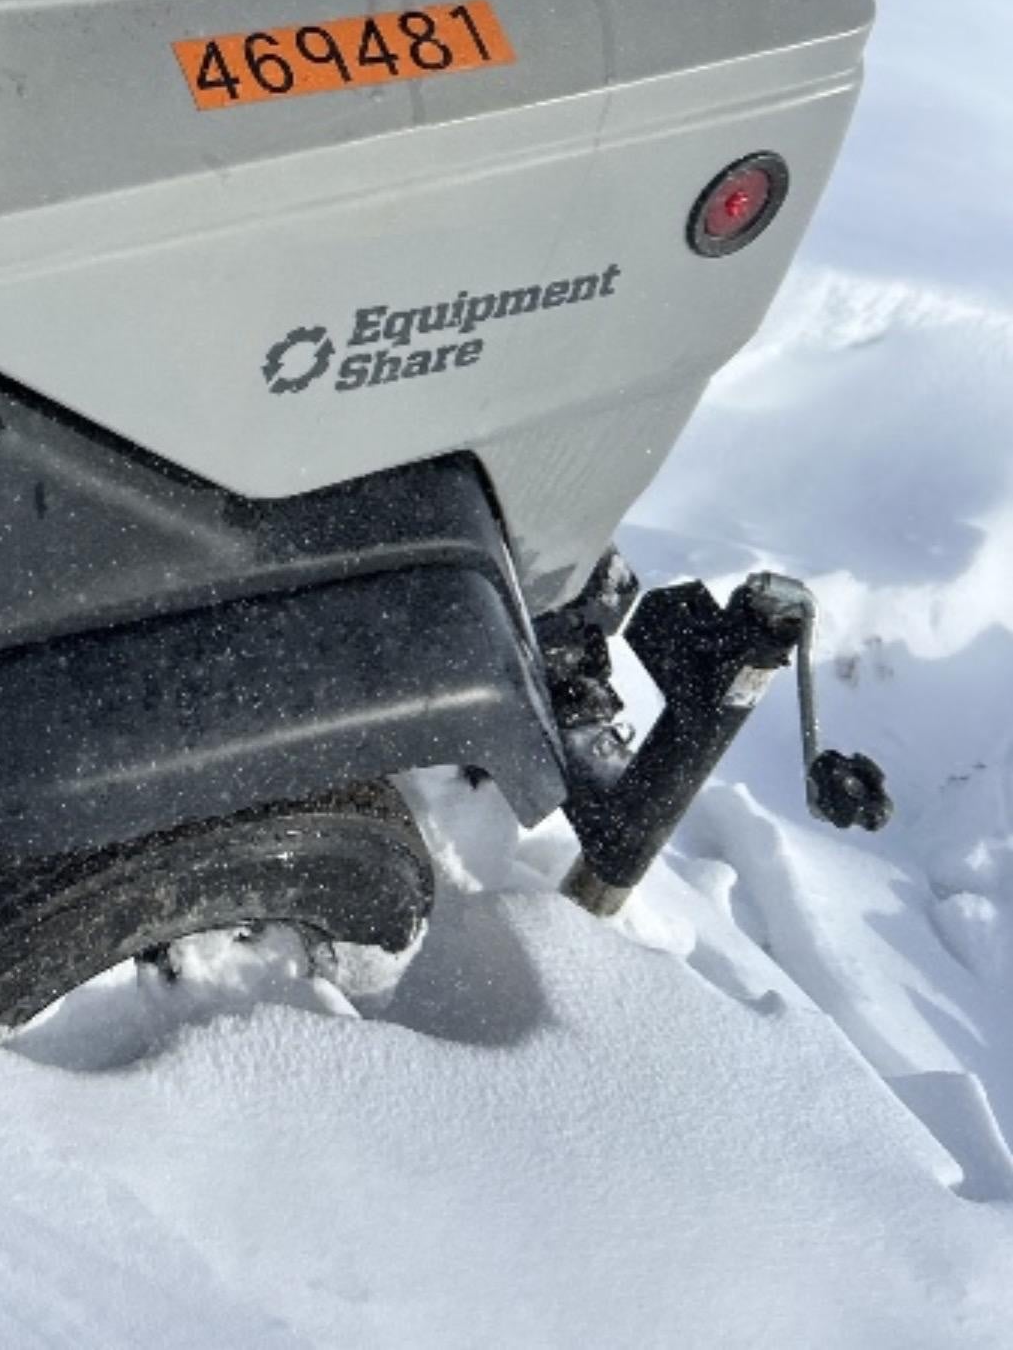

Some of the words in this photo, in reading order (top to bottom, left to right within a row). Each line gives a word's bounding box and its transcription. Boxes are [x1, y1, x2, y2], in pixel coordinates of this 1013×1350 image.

[196, 5, 492, 100] 469481
[346, 263, 621, 348] Equipment
[334, 338, 484, 392] Share
